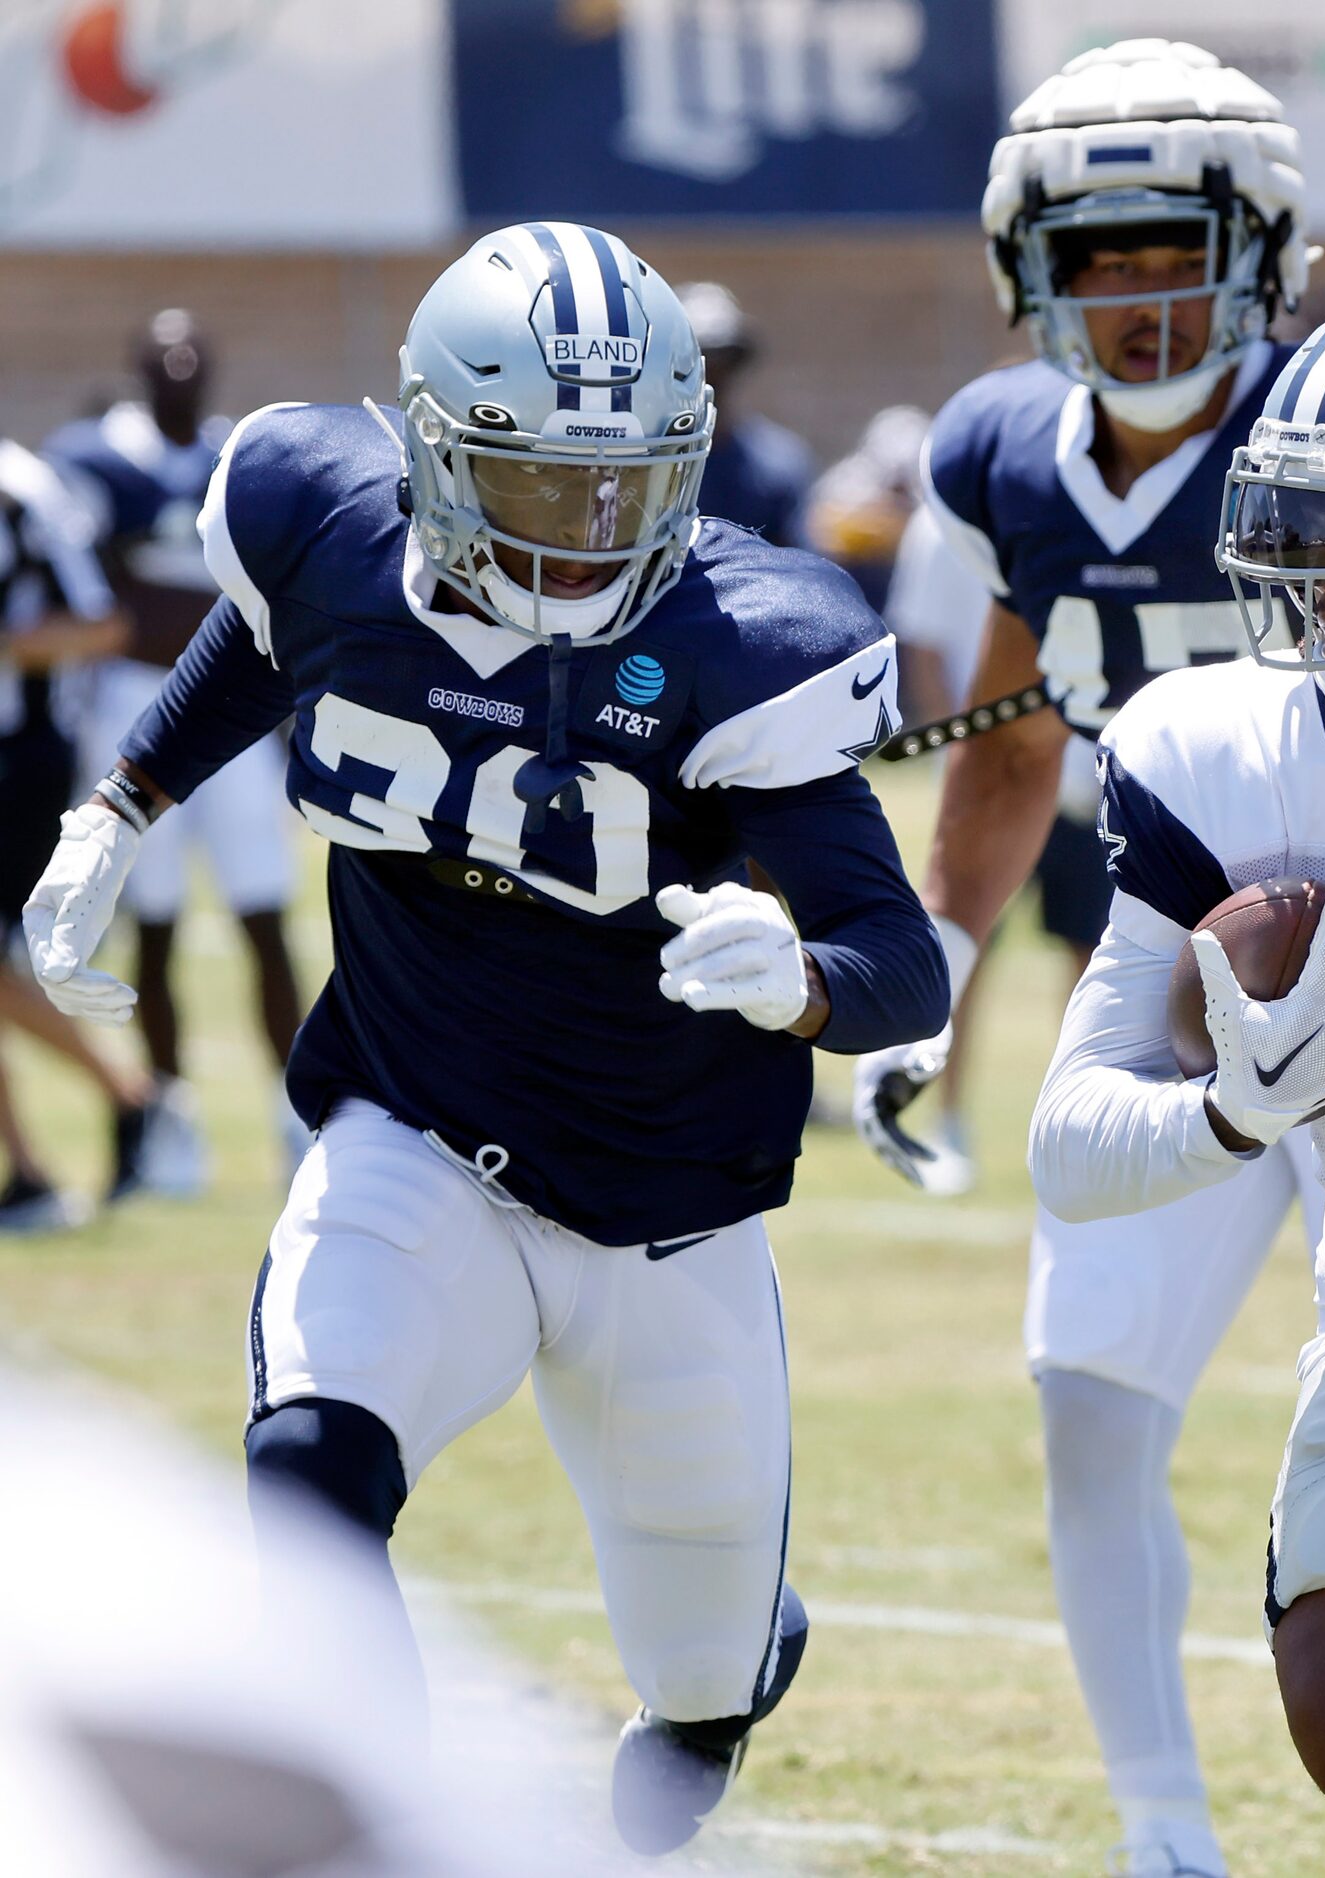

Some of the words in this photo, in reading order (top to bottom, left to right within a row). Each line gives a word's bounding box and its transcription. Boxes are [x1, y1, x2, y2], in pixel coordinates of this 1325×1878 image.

[554, 339, 638, 363] BLAND
[566, 425, 627, 438] COWBOYS
[428, 687, 525, 727] COWBOYS
[595, 703, 660, 738] AT&T
[297, 691, 650, 916] 30
